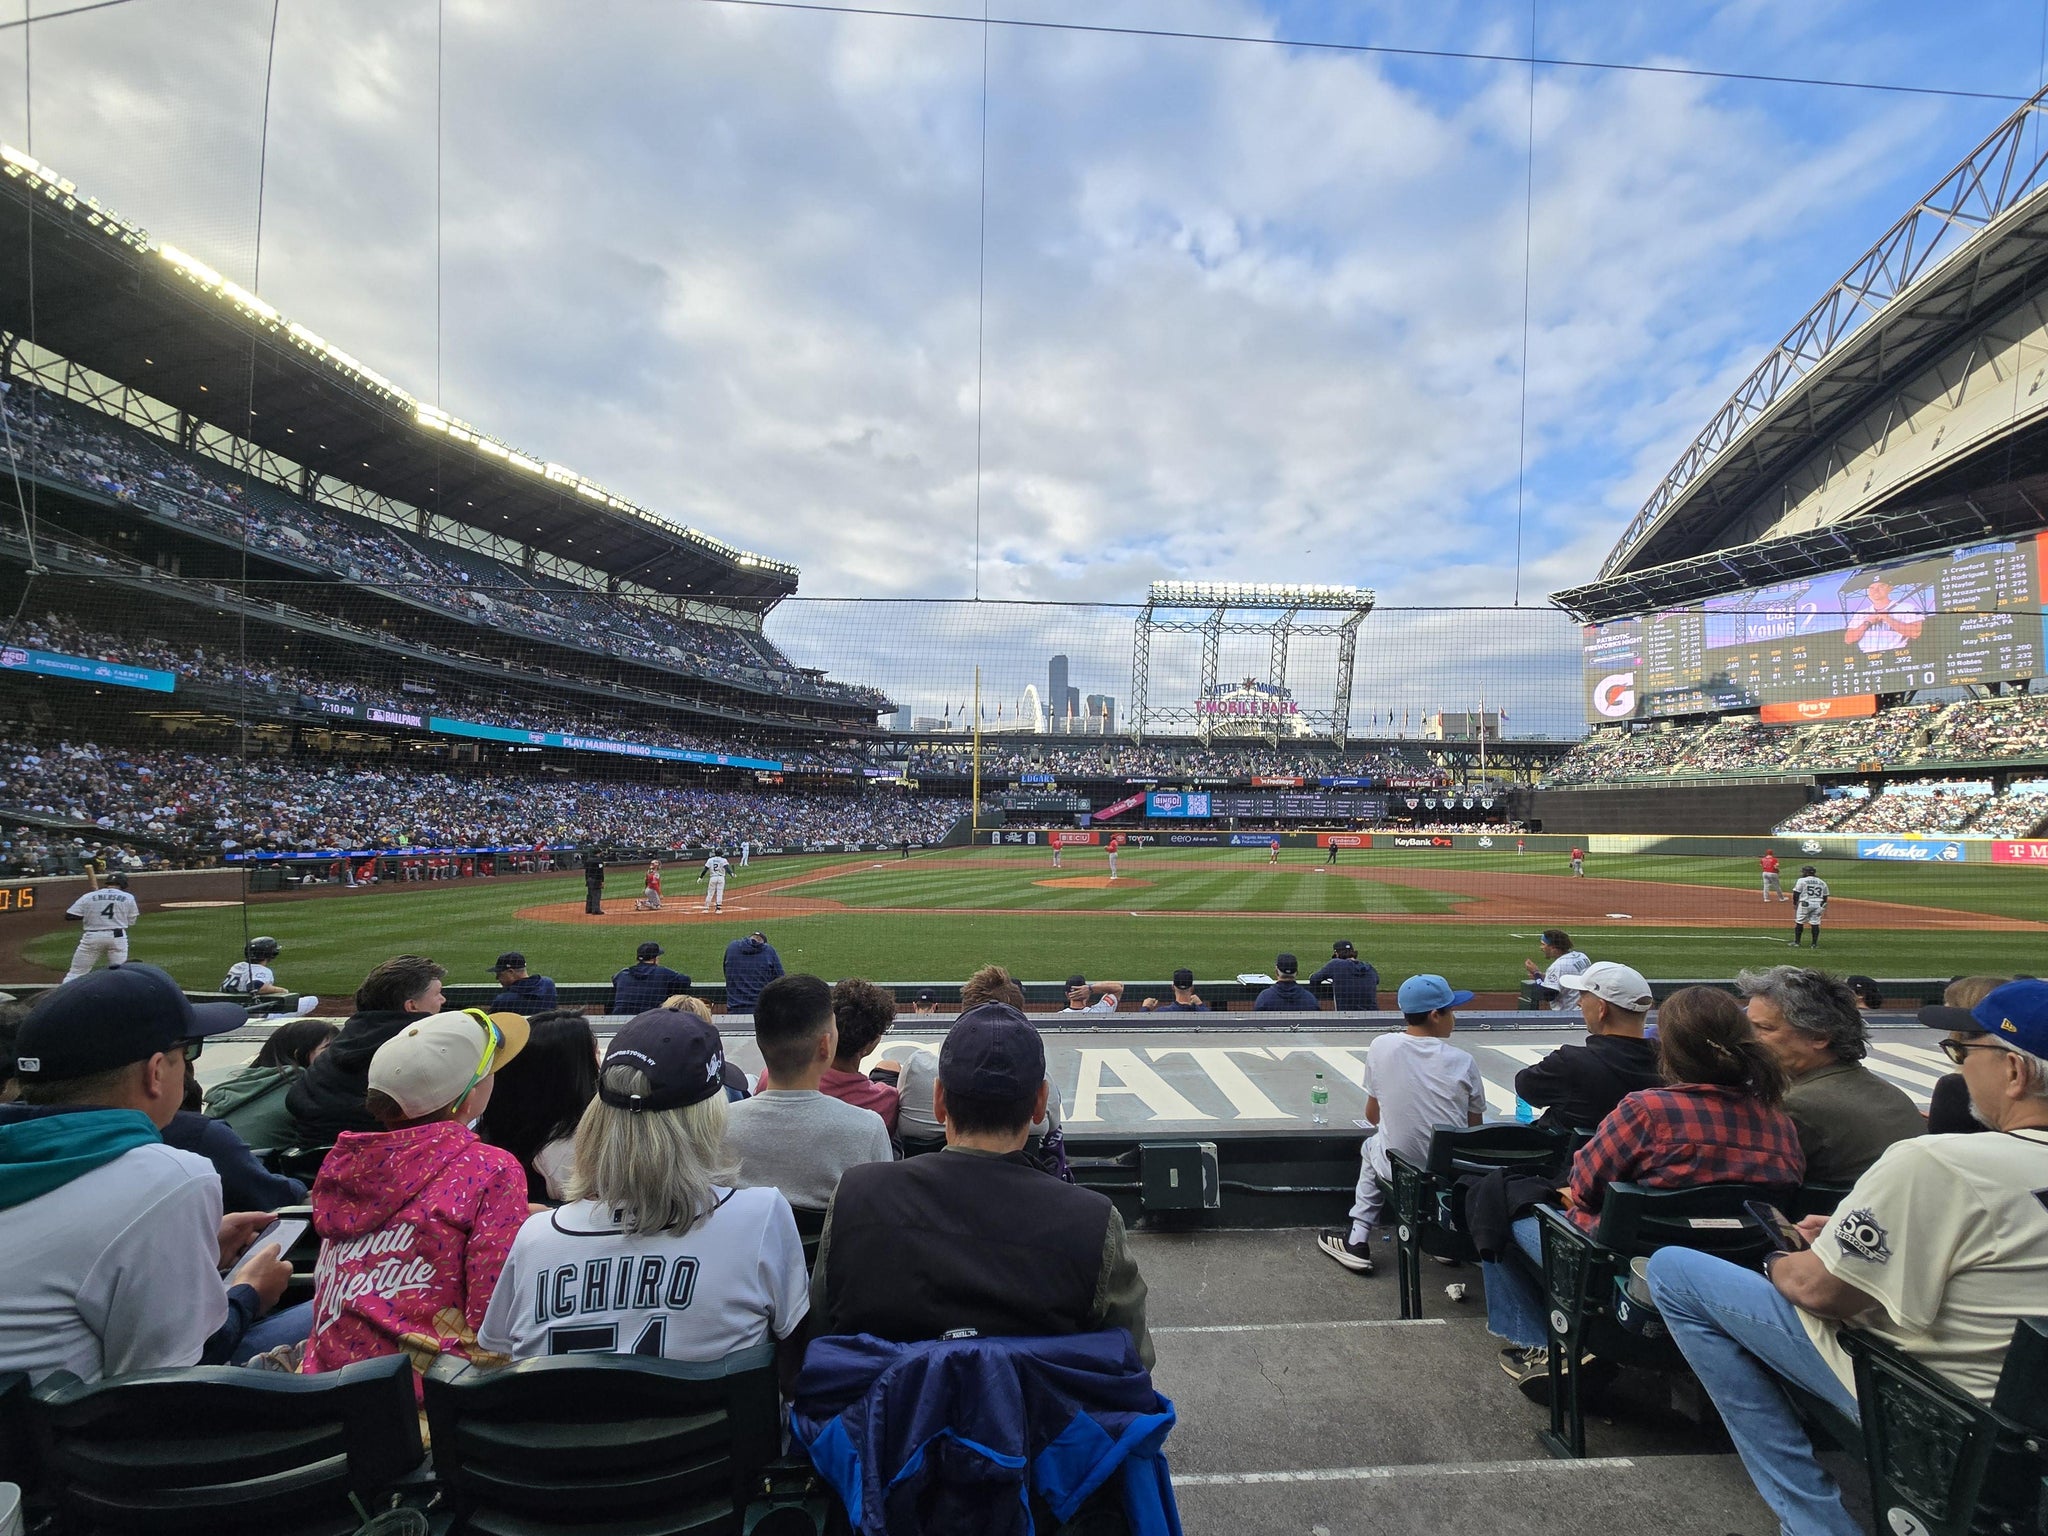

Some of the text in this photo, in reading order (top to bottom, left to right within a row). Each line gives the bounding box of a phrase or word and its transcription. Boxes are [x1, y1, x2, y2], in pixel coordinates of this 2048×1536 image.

[1950, 562, 1986, 574] Crawford
[2009, 554, 2026, 563] .217
[1951, 563, 2027, 581] Rodriguez CF .256
[1951, 581, 1977, 590] Naylor
[2009, 571, 2028, 579] .254
[1952, 586, 1992, 597] Arozarena
[2010, 579, 2028, 588] .279
[1952, 596, 1981, 605] Raleigh
[1952, 605, 1977, 613] Young
[2010, 596, 2029, 604] .260
[1766, 602, 1818, 630] COLE 2
[1961, 618, 1977, 626] July
[1992, 613, 2012, 621] 2003
[1747, 621, 1795, 638] YOUNG
[1960, 620, 2001, 631] Pittsburgh,
[1584, 641, 1621, 652] FIREWORKS
[1621, 636, 1643, 646] NIGHT
[1596, 632, 1631, 644] PATRIOTIC
[1992, 633, 2013, 641] 2025
[1791, 652, 1807, 660] .713
[1894, 656, 1912, 664] .392
[1956, 650, 1990, 659] Emerson
[1957, 658, 1983, 666] Robles
[36, 659, 81, 672] PRESENTED
[114, 670, 149, 681] FARMERS
[2015, 660, 2034, 668] .217
[1906, 673, 1914, 686] 1
[1923, 671, 1935, 685] 0
[1256, 682, 1292, 698] MARINERS
[321, 702, 422, 727] 7:10 PM BALLPARK
[1261, 700, 1300, 715] PARK
[1798, 702, 1831, 712] fire tv
[562, 737, 584, 749] PLAY
[585, 741, 626, 753] MARINERS
[626, 744, 650, 755] BINGO
[652, 750, 678, 758] PRESENTED
[1395, 838, 1431, 847] KeyBank
[1863, 842, 1929, 860] Alaska
[713, 863, 719, 872] 2
[92, 894, 127, 903] EMERSON
[1806, 885, 1822, 897] 53
[101, 902, 115, 920] 4
[646, 1057, 657, 1067] NY
[1843, 1214, 1880, 1247] 50
[535, 1255, 701, 1325] ICHIRO
[1903, 1519, 1916, 1536] 7
